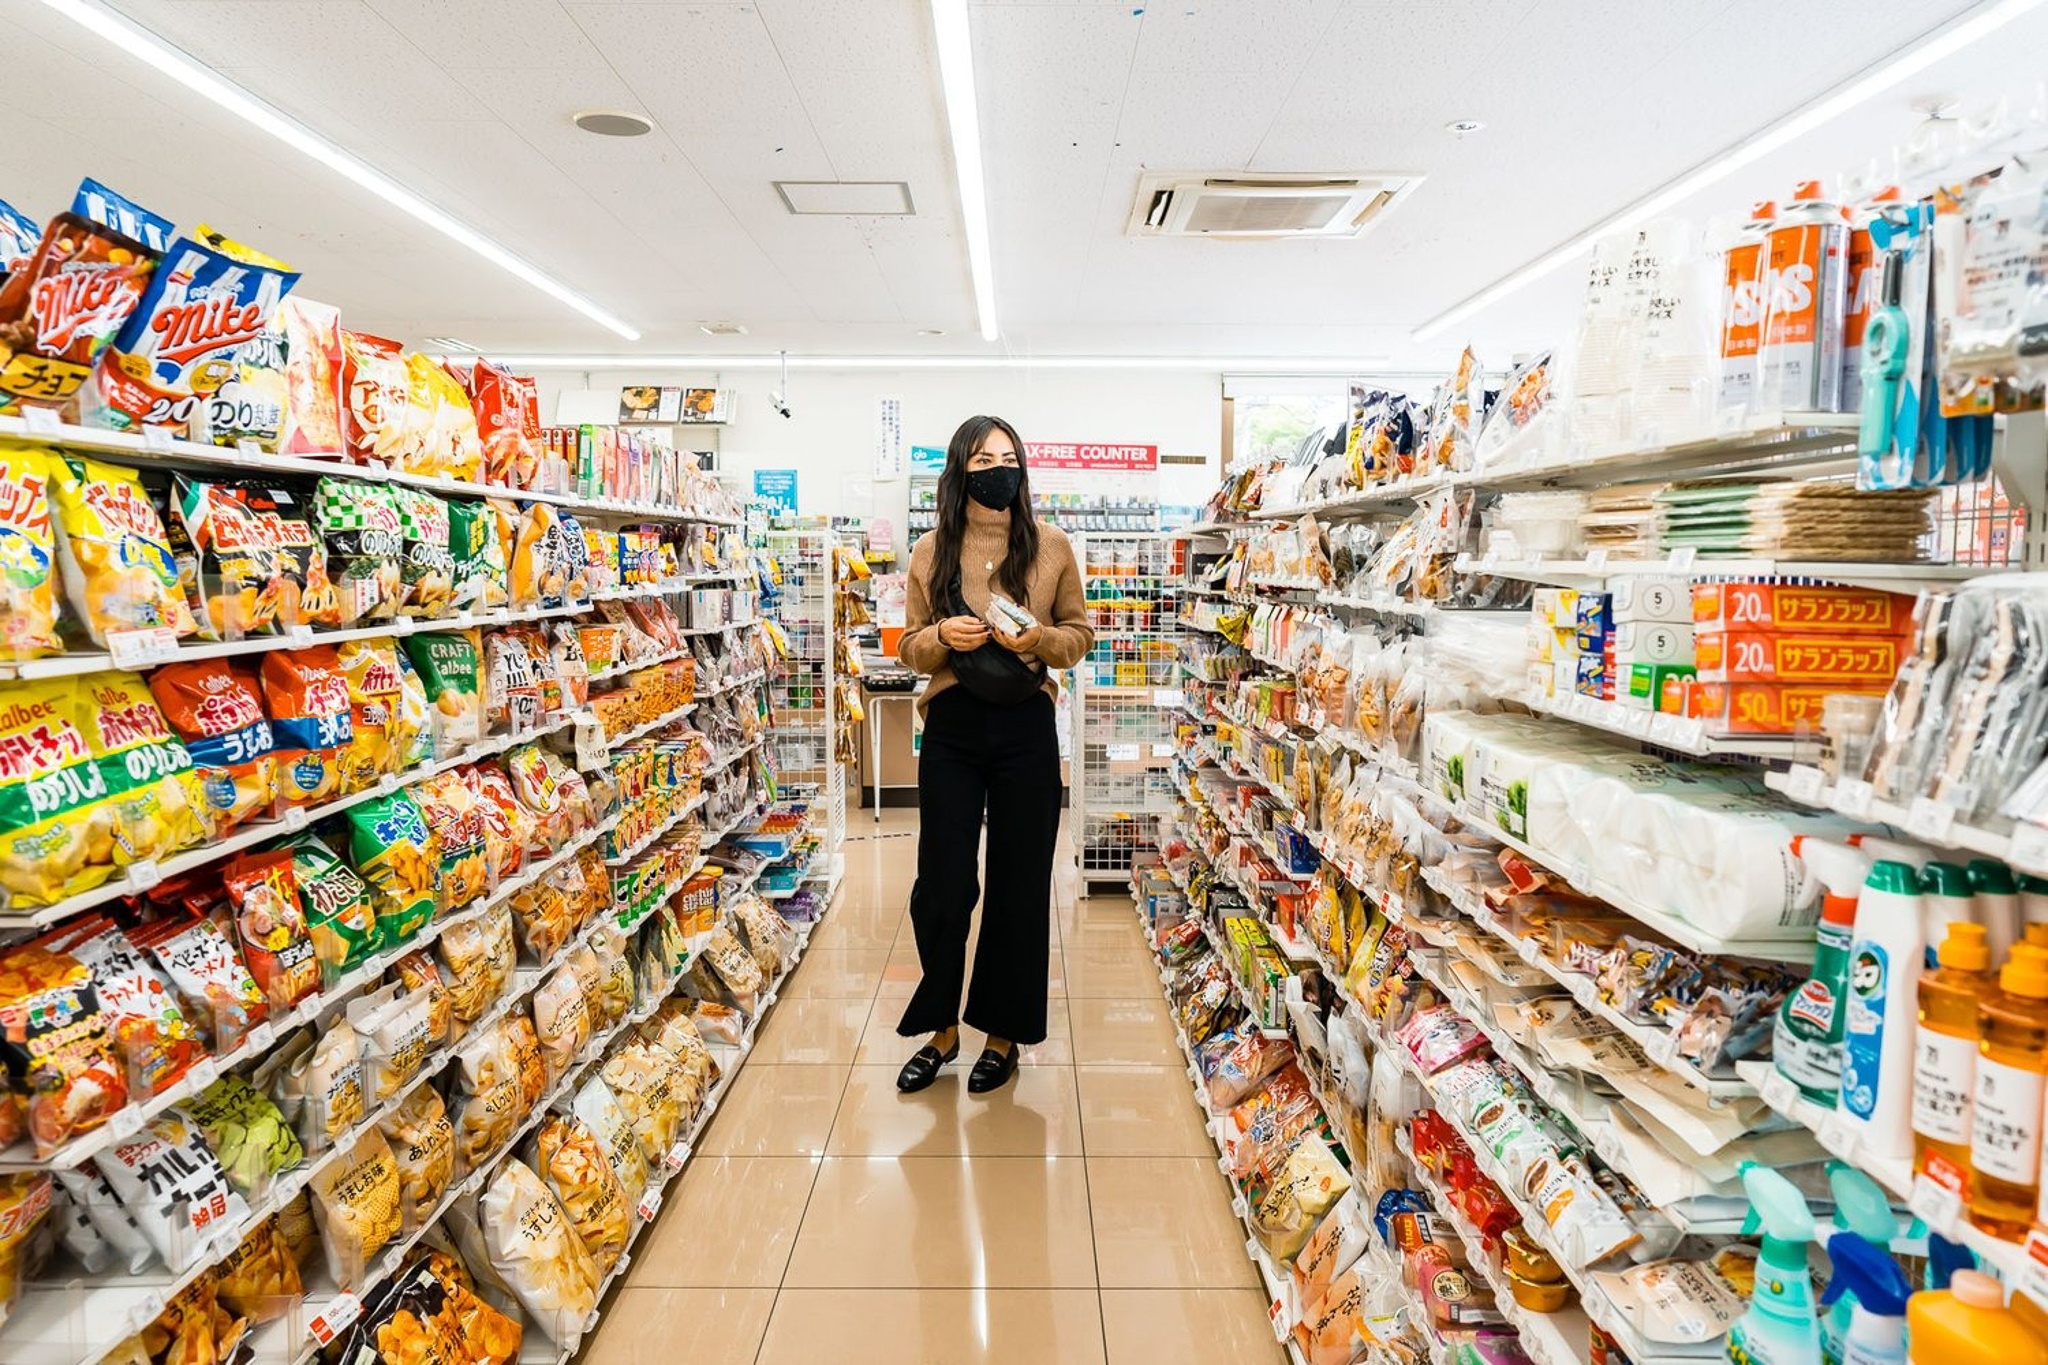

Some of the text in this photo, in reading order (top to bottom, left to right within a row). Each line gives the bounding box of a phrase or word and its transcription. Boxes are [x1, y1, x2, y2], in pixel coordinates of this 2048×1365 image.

[151, 295, 265, 348] Mike
[1025, 445, 1148, 461] AX-FREE COUNTER
[1654, 592, 1663, 604] 5
[1781, 597, 1884, 622] サランラップ
[1657, 635, 1665, 648] 5
[430, 643, 471, 658] CRAFT
[1784, 647, 1888, 672] サランラップ
